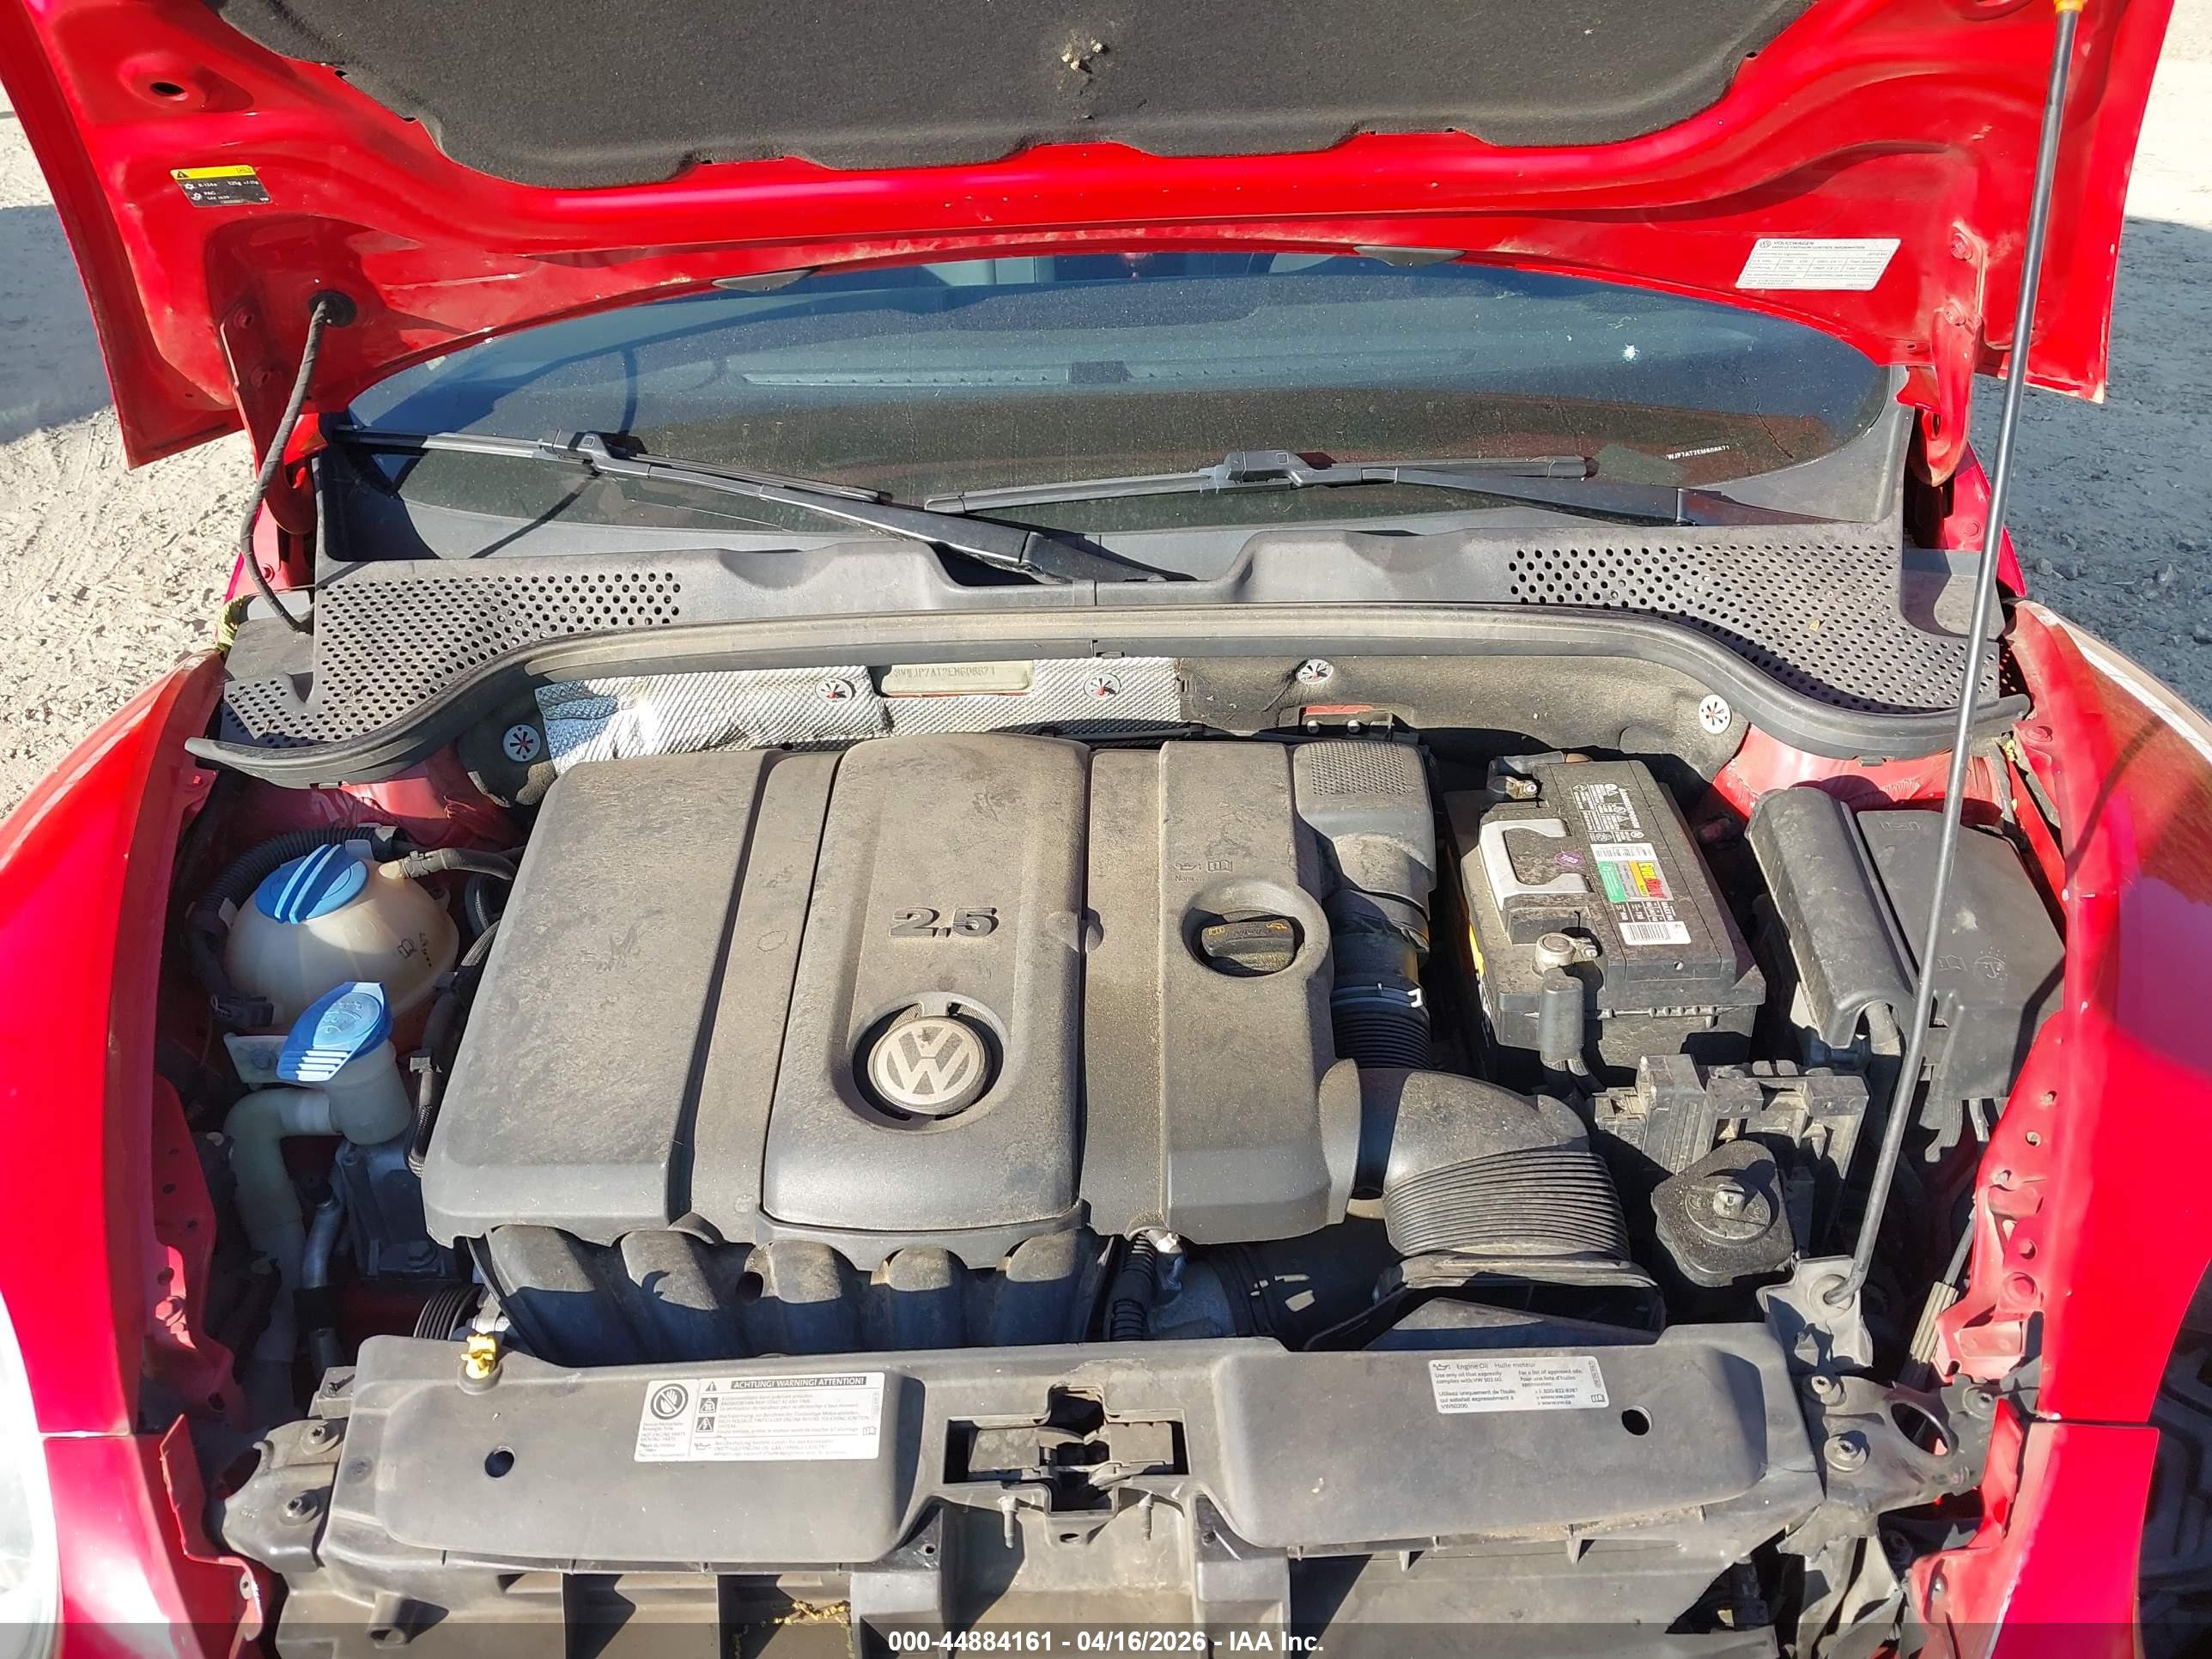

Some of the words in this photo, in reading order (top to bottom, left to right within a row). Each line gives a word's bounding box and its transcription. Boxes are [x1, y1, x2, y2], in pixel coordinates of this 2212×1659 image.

[890, 907, 999, 938] 2.5
[877, 1018, 981, 1105] VW
[733, 1380, 775, 1389] ACHTUNG!
[776, 1378, 817, 1388] WARNING!
[818, 1376, 865, 1386] ATTENTION!
